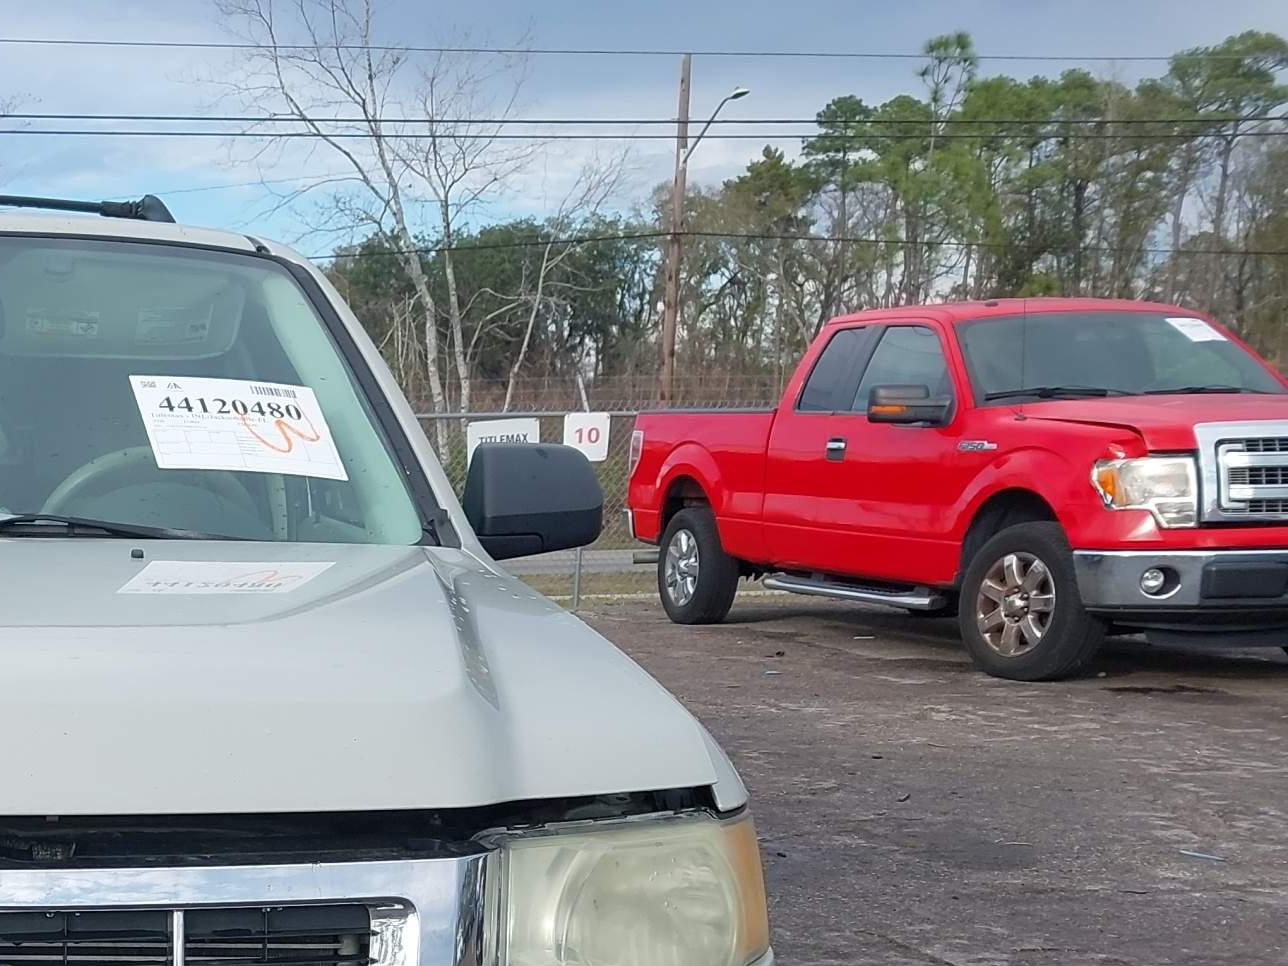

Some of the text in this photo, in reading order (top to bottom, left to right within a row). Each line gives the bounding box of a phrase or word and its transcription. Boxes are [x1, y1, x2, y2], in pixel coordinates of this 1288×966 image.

[158, 396, 303, 421] 44120480
[478, 432, 529, 444] TITLEMAX
[574, 427, 601, 444] 10
